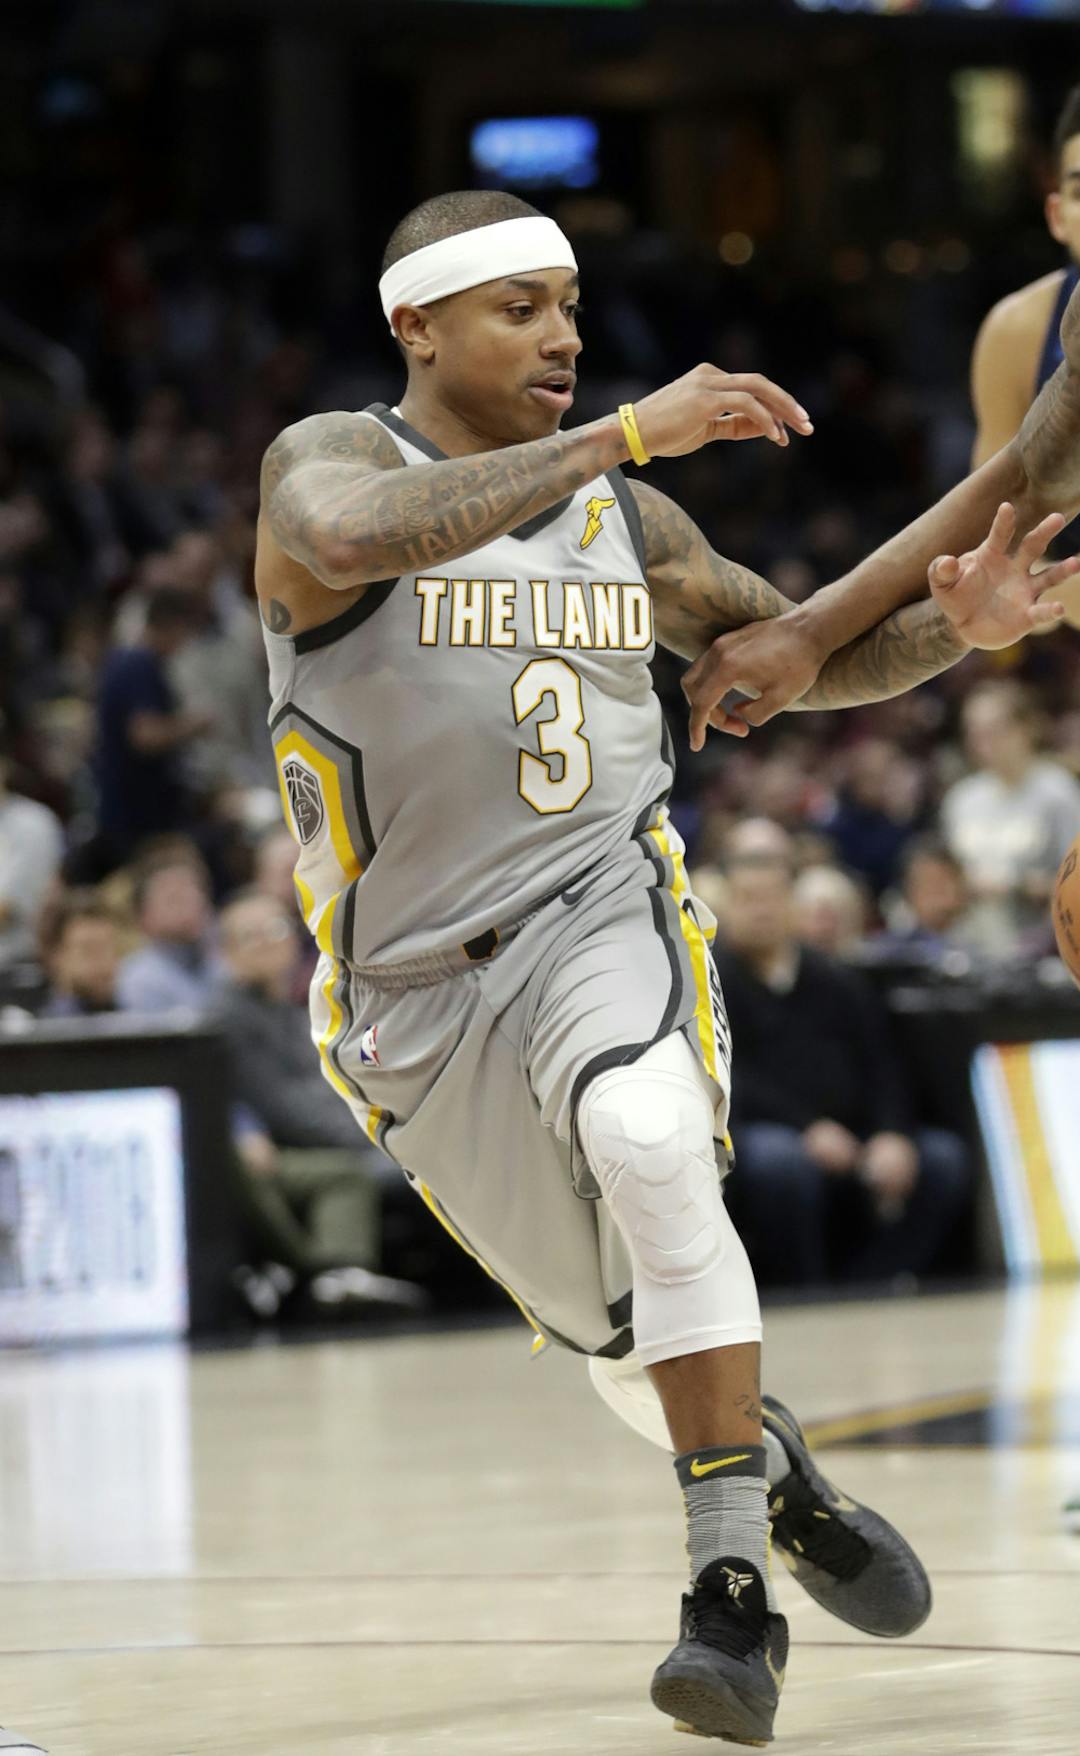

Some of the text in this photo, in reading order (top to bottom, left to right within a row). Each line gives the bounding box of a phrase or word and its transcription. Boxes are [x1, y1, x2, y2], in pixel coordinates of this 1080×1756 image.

[414, 577, 653, 650] THE LAND
[511, 656, 593, 815] 3
